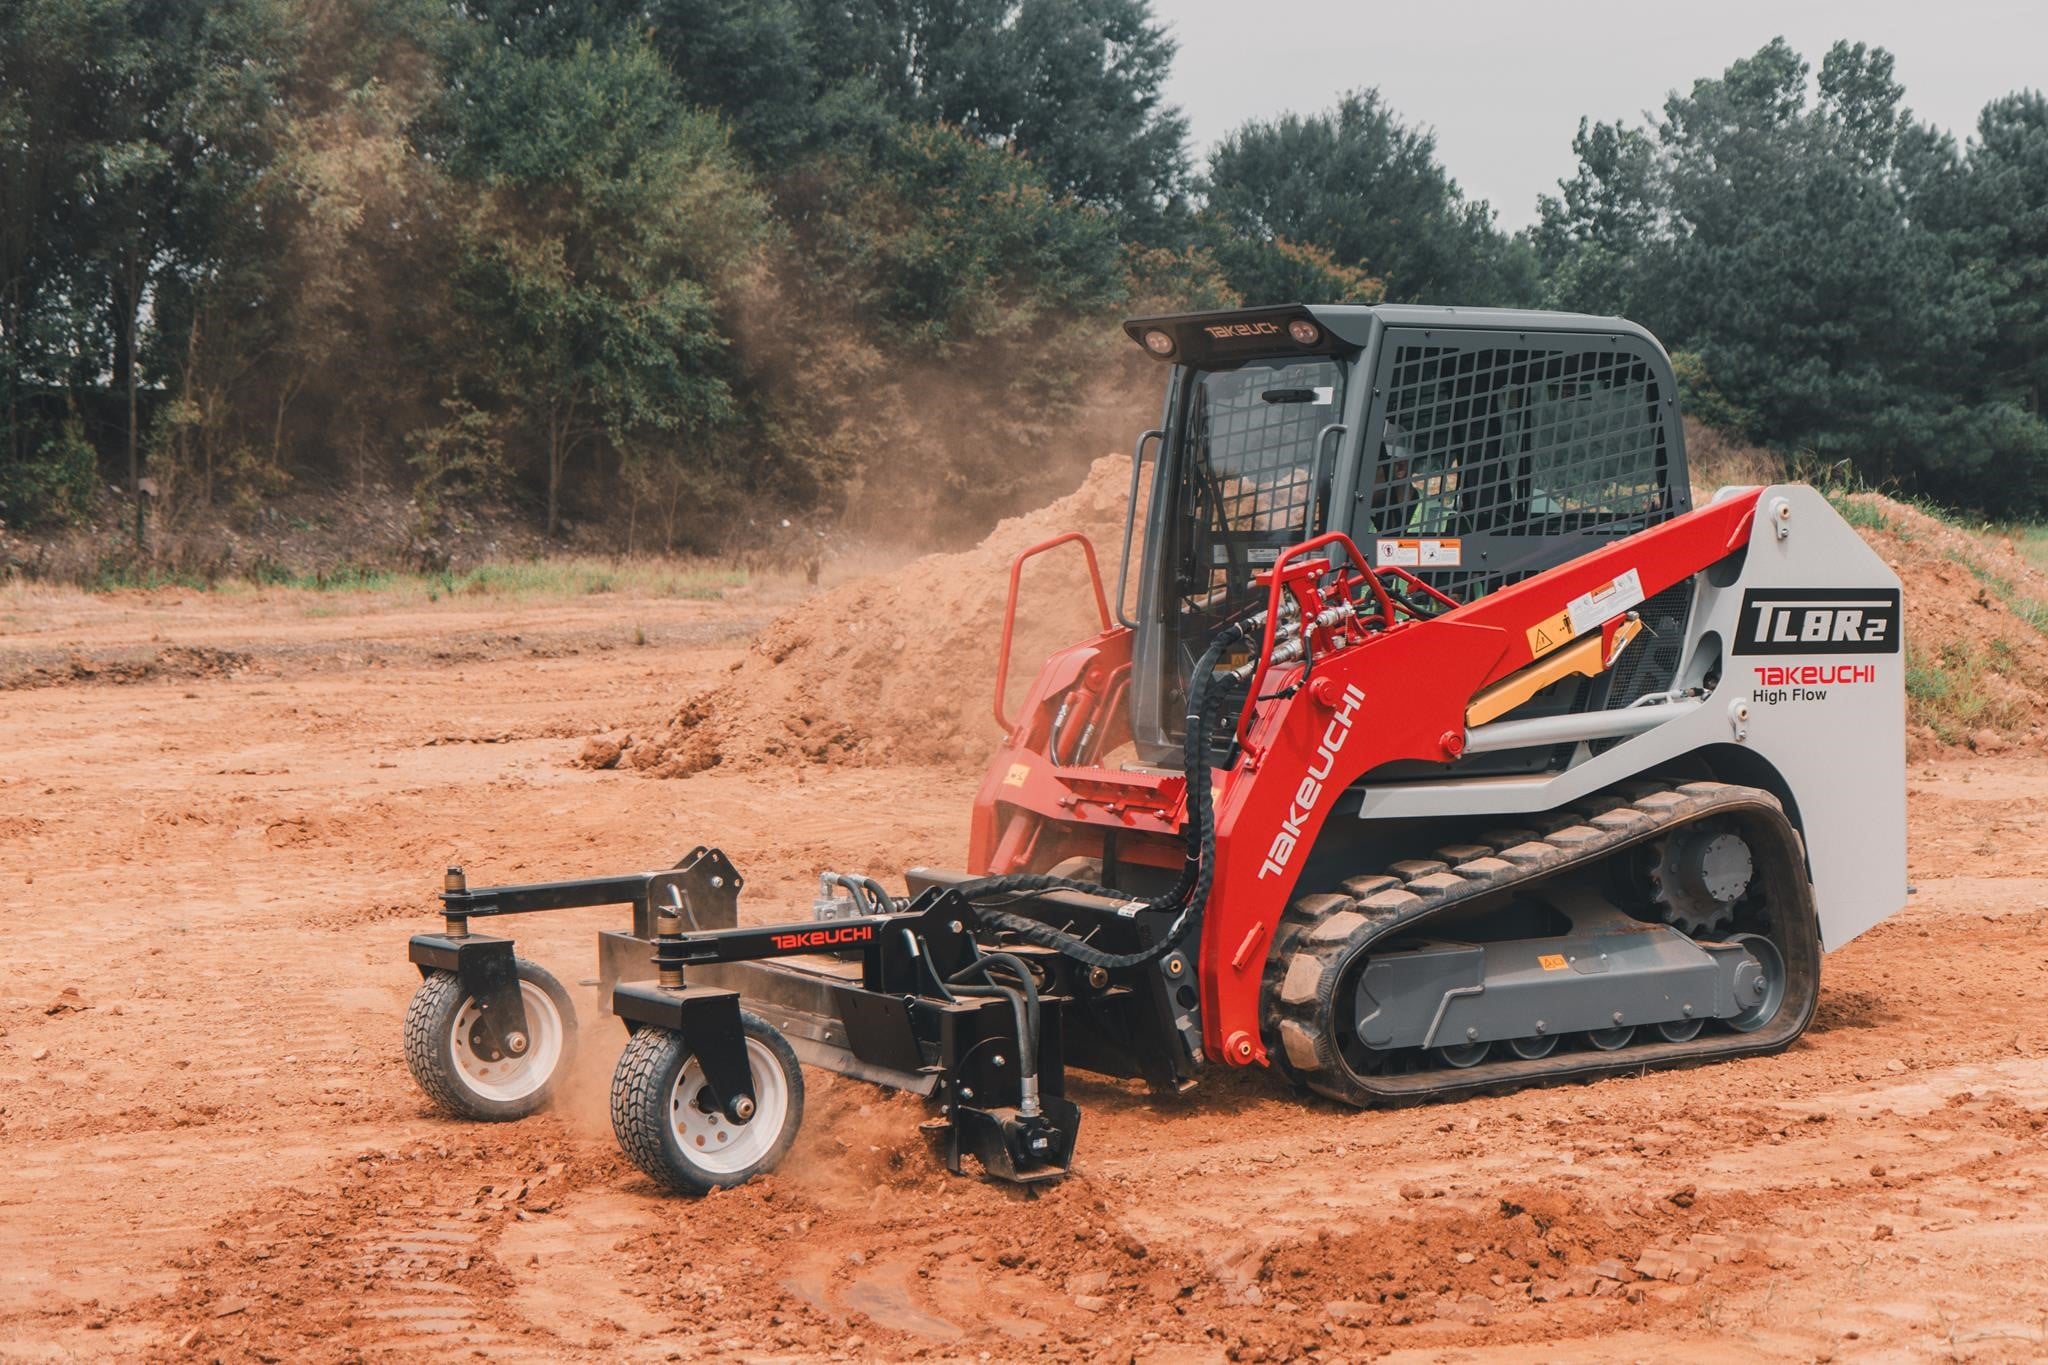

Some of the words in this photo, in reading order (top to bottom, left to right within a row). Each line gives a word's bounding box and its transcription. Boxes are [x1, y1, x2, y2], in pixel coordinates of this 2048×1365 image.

[1203, 322, 1279, 338] TAKEUCH
[1752, 601, 1892, 642] TL8R2
[1754, 665, 1875, 685] TAKEUCHI
[1753, 690, 1787, 705] High
[1792, 689, 1827, 701] Flow
[1258, 683, 1366, 879] TAKEUCHI
[771, 927, 872, 949] TAKEUCHI
